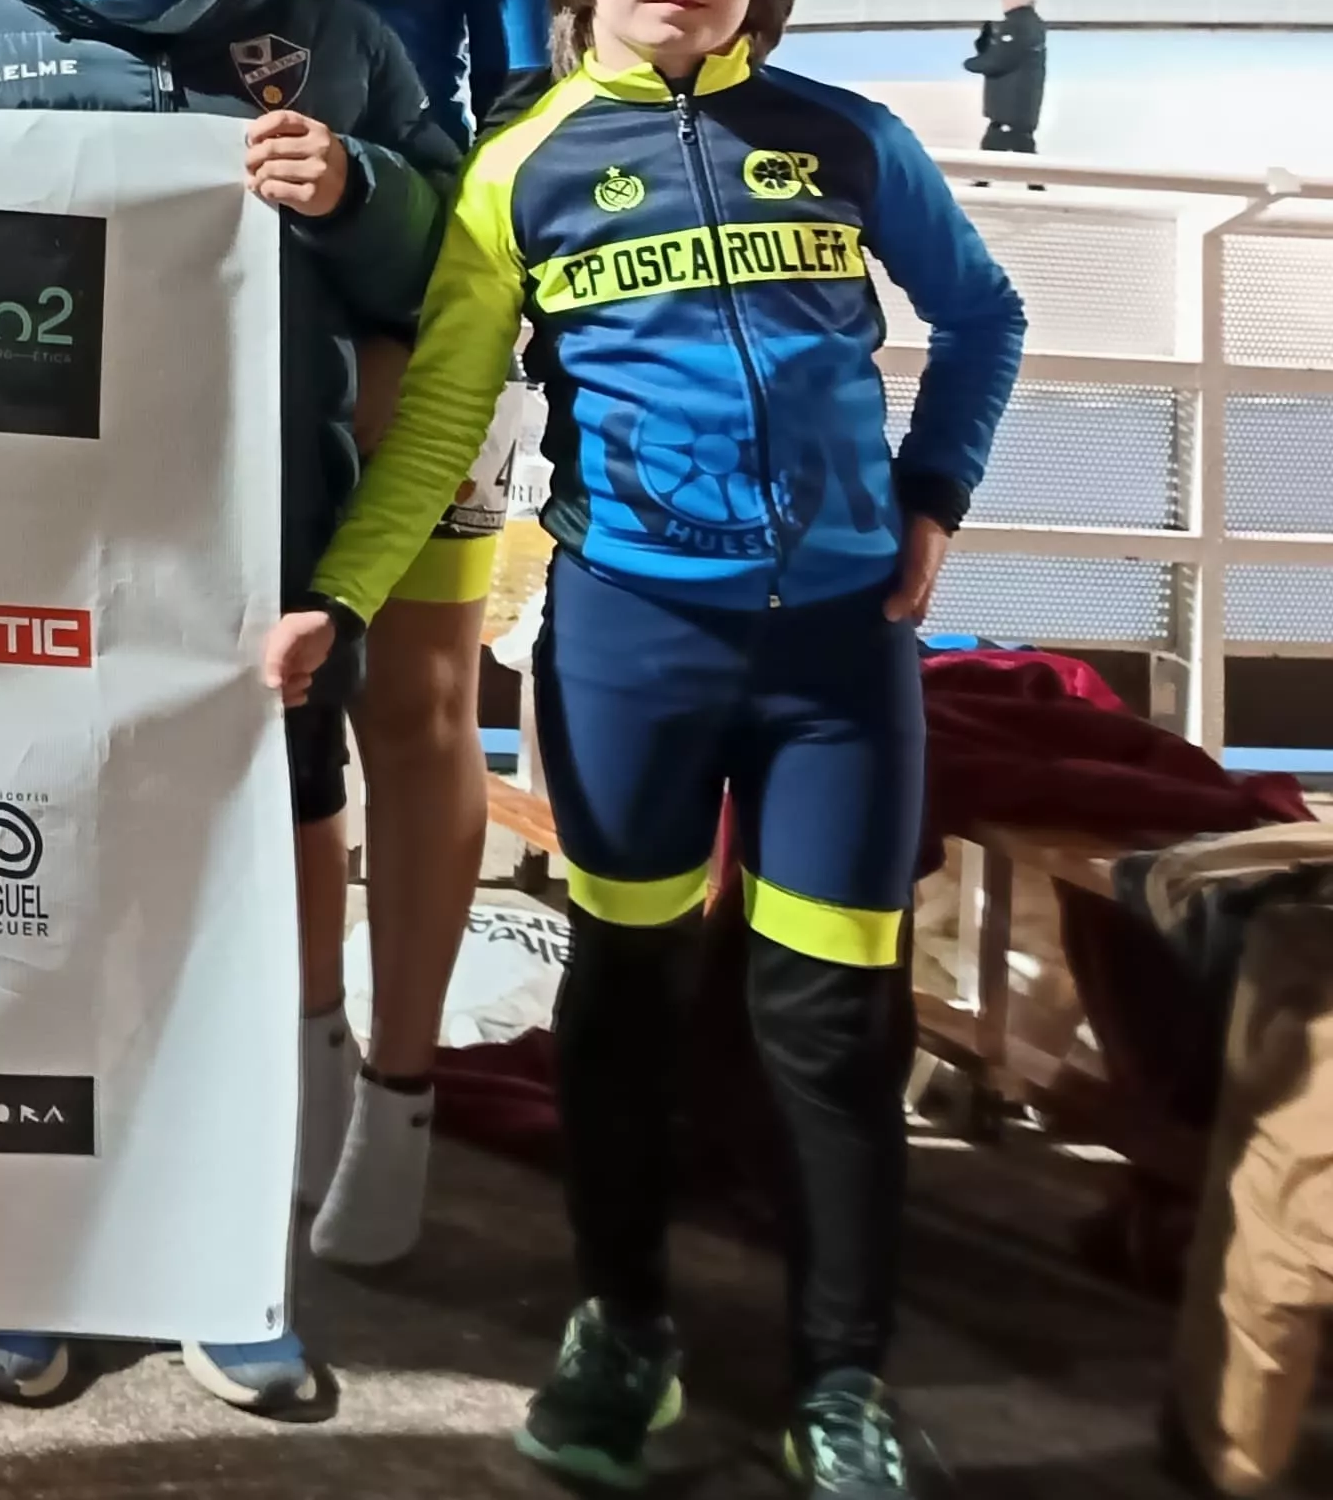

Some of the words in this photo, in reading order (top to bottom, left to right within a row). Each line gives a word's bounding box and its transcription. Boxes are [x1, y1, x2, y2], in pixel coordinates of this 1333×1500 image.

[563, 256, 605, 300] CP
[617, 237, 713, 291] OSCA
[725, 229, 847, 275] ROLLER
